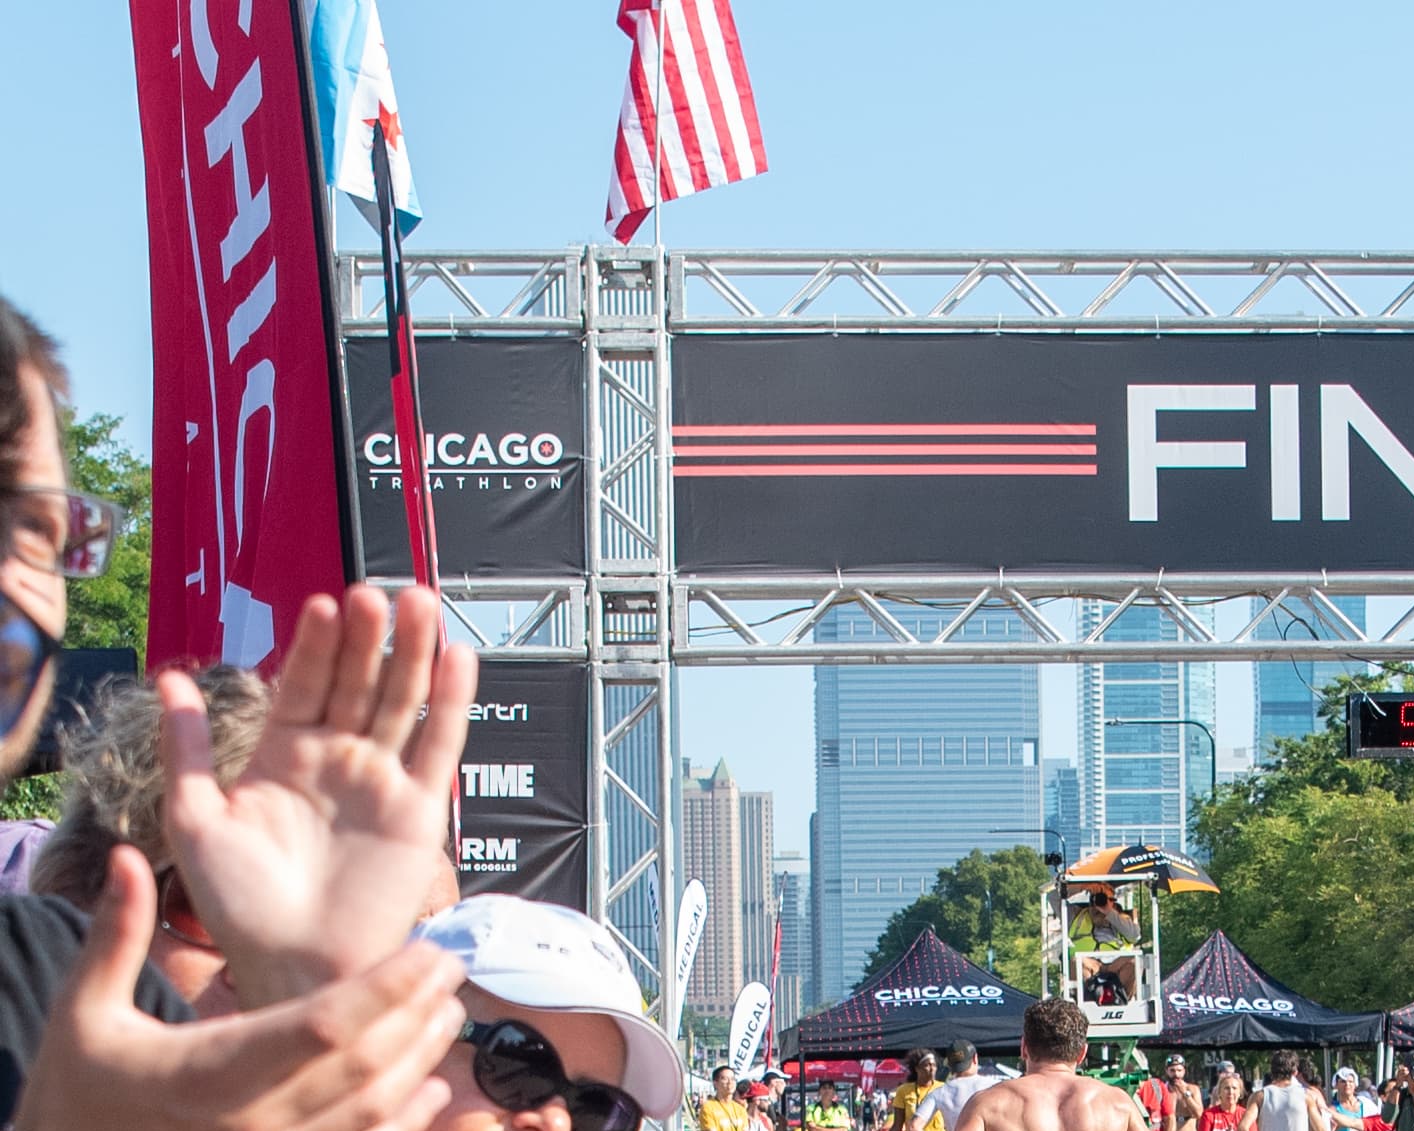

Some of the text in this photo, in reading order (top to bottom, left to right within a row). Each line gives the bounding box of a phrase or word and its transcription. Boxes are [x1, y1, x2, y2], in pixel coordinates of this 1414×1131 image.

[364, 432, 563, 466] CICAGO
[369, 476, 562, 490] TRATHLON
[461, 763, 535, 797] TIME
[460, 837, 517, 861] RM
[473, 863, 517, 871] GOGGLES
[677, 903, 704, 983] MEDICAL
[874, 985, 1003, 1000] CHICAGO
[1168, 993, 1294, 1011] CHICAGO
[1102, 1011, 1125, 1019] JLG
[733, 1000, 768, 1077] MEDICAL
